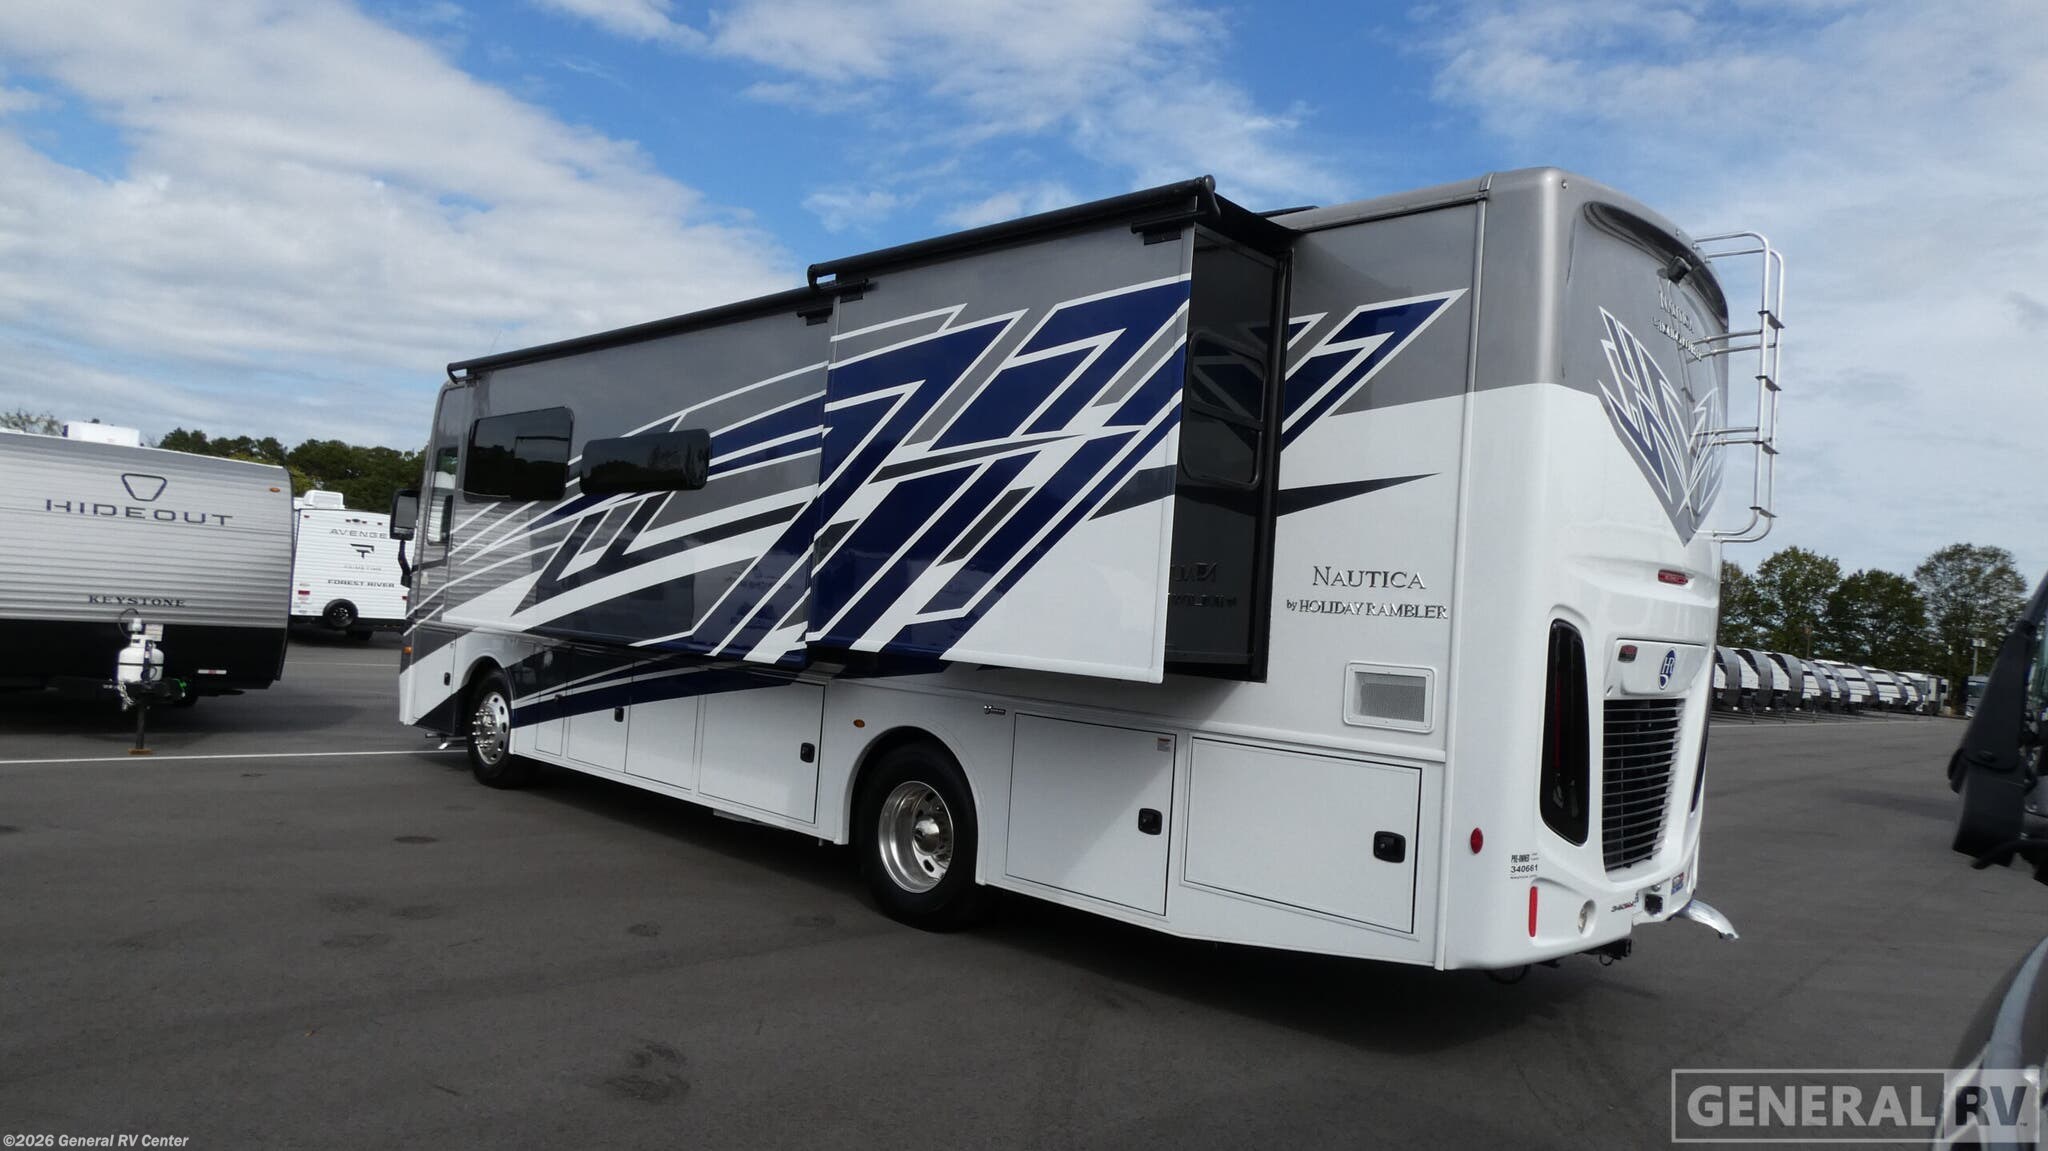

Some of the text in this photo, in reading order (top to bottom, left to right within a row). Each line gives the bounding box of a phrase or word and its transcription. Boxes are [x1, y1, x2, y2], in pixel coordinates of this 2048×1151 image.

[46, 499, 233, 526] HIDEOUT
[329, 528, 388, 539] AVENGE
[328, 579, 364, 587] FOREST
[1312, 566, 1426, 589] NAUTICA
[89, 594, 186, 609] KEYSTONE
[1286, 599, 1449, 619] by HOLIDAY RAMBLER
[1510, 864, 1538, 873] 340661
